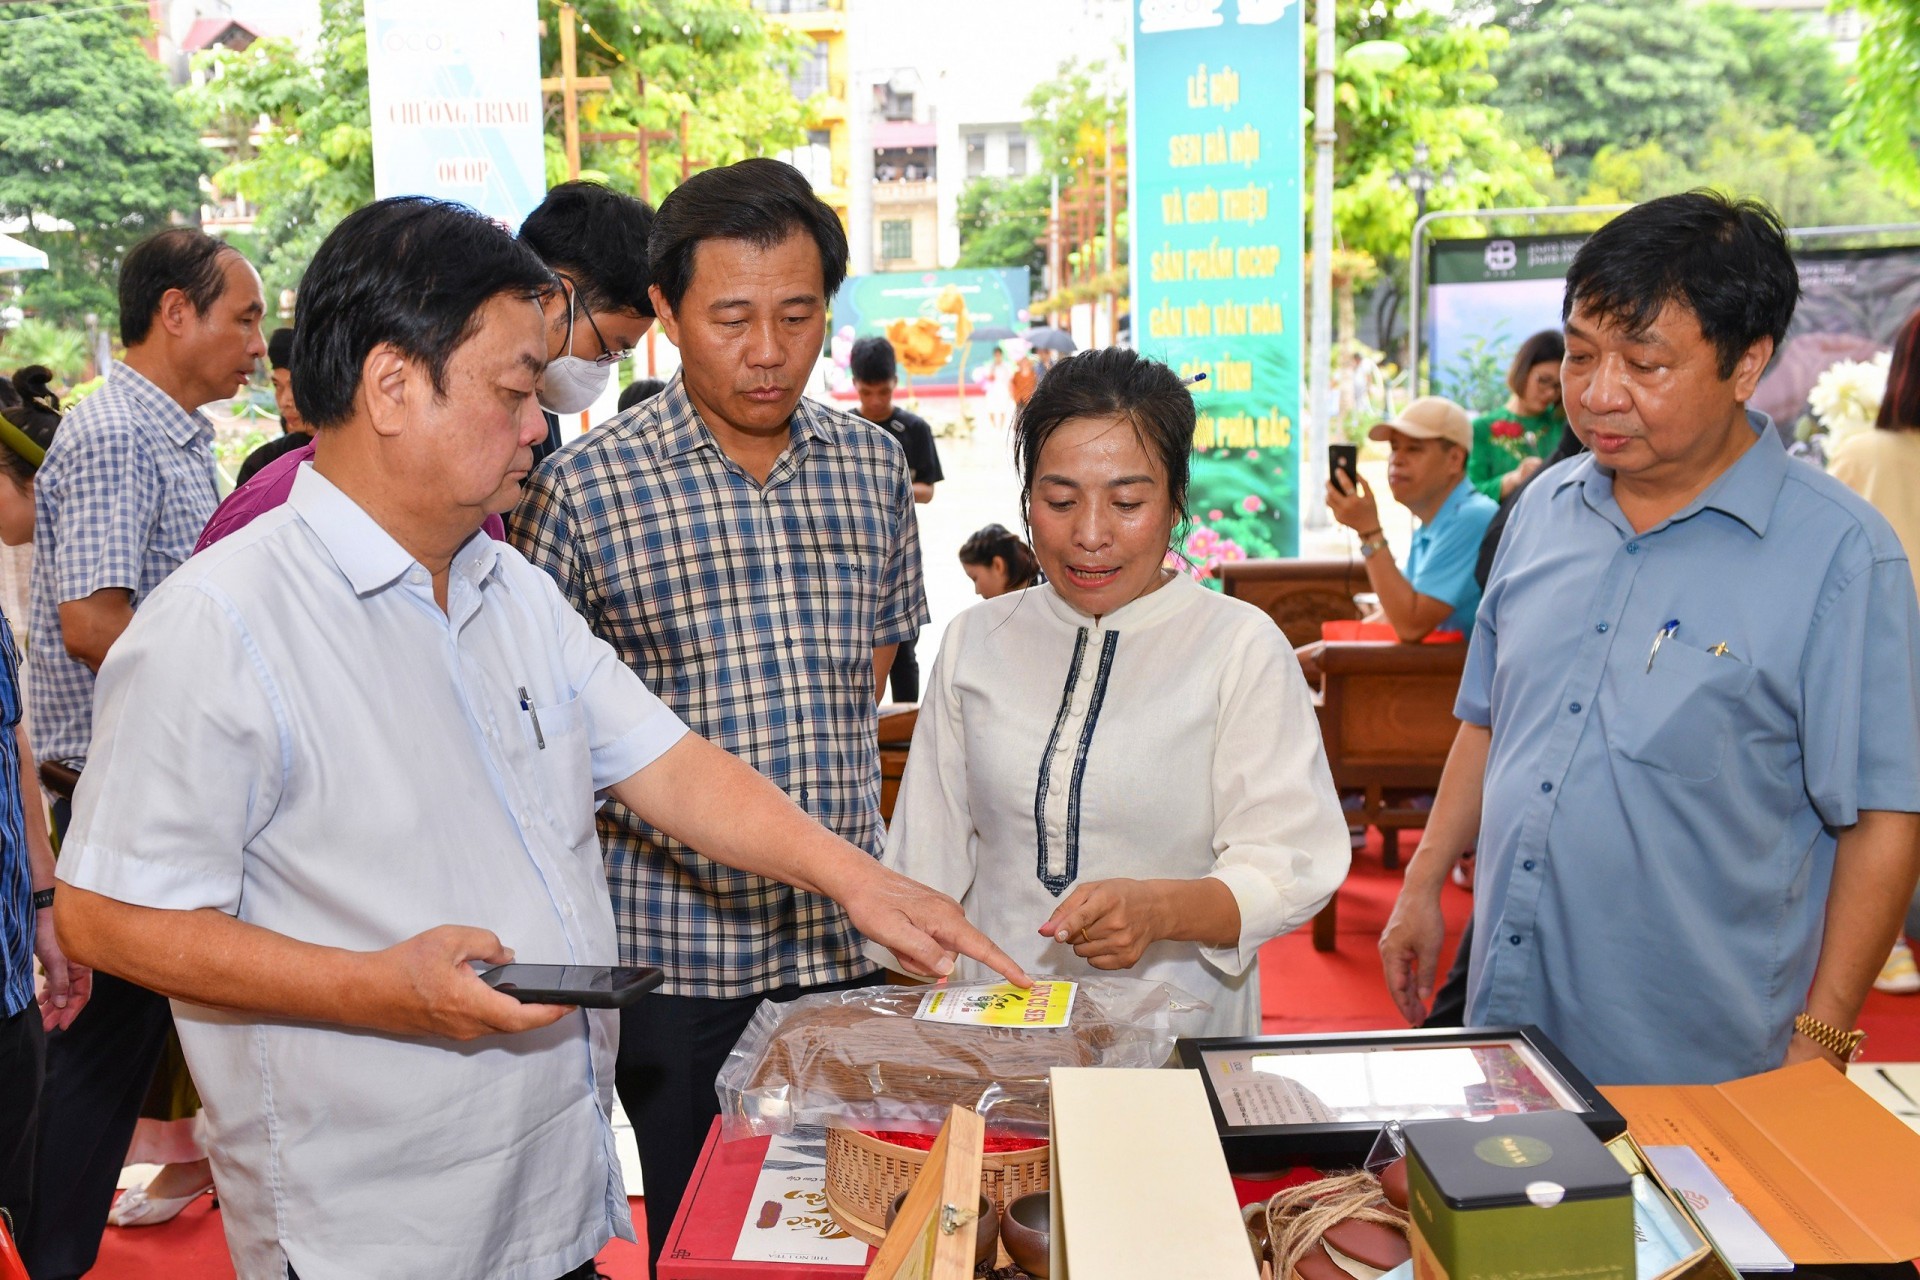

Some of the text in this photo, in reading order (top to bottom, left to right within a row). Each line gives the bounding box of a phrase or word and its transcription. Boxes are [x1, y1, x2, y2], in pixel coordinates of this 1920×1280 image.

[1170, 134, 1202, 167] SEN
[437, 160, 490, 184] OCOP
[1222, 181, 1268, 227] THIỆU
[1237, 244, 1281, 278] OCOP
[1023, 1008, 1047, 1023] SEN
